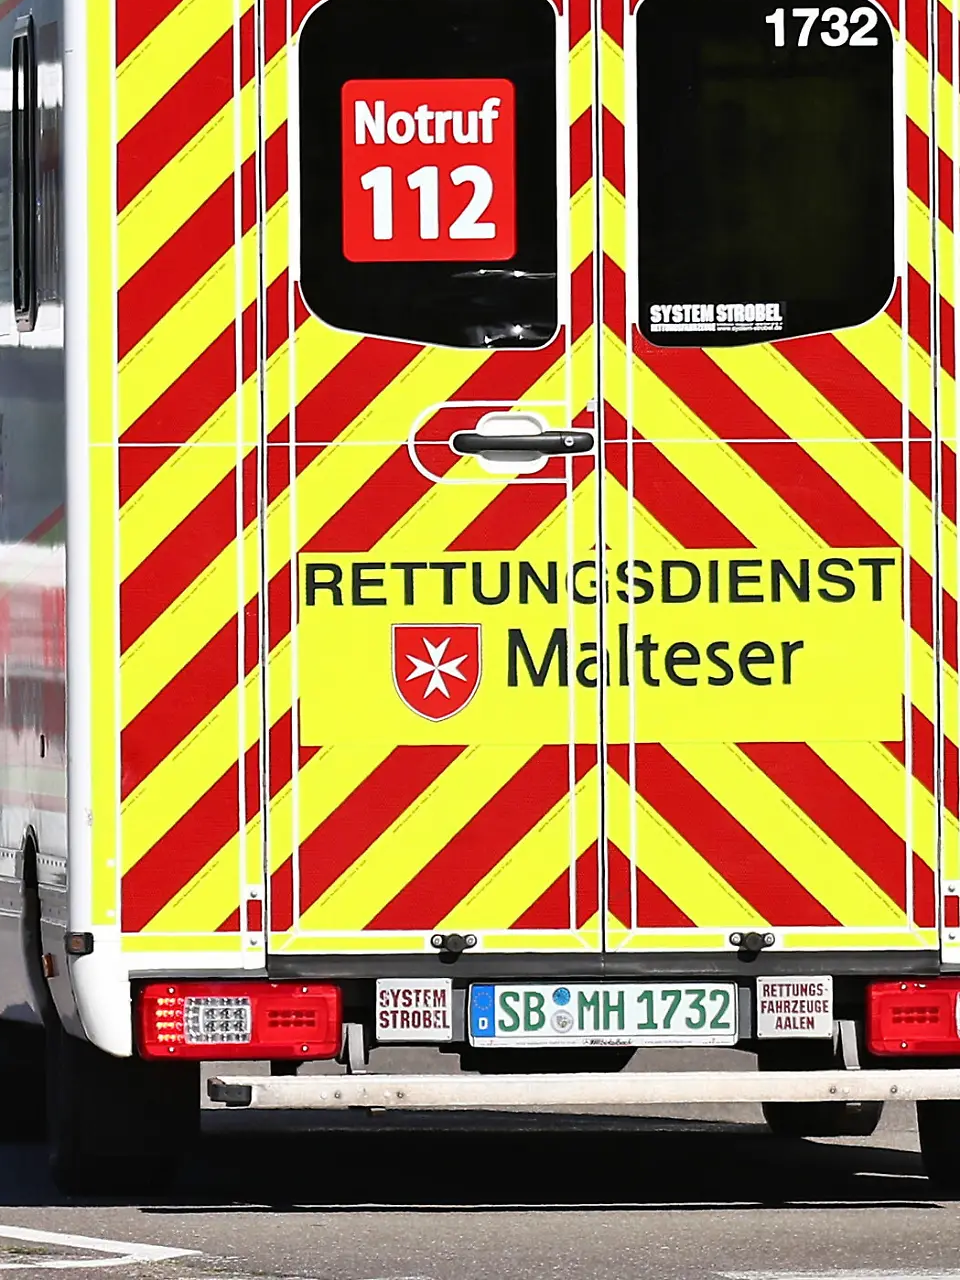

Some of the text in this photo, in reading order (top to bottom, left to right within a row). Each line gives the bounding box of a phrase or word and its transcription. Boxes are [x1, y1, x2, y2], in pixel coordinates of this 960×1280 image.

[765, 6, 879, 48] 1732
[354, 97, 502, 145] Notruf
[360, 164, 497, 241] 112
[650, 303, 783, 323] SYSTEM STROBEL
[305, 557, 896, 607] RETTUNGSDIENST
[506, 623, 804, 688] Malteser
[379, 989, 446, 1008] SYSTEM
[763, 983, 829, 997] RETTUNGS-
[379, 1010, 450, 1029] STROBEL
[478, 989, 731, 1032] D SB MH 1732
[761, 1000, 829, 1013] FAHRZEUGE
[776, 1016, 815, 1030] AALEN
